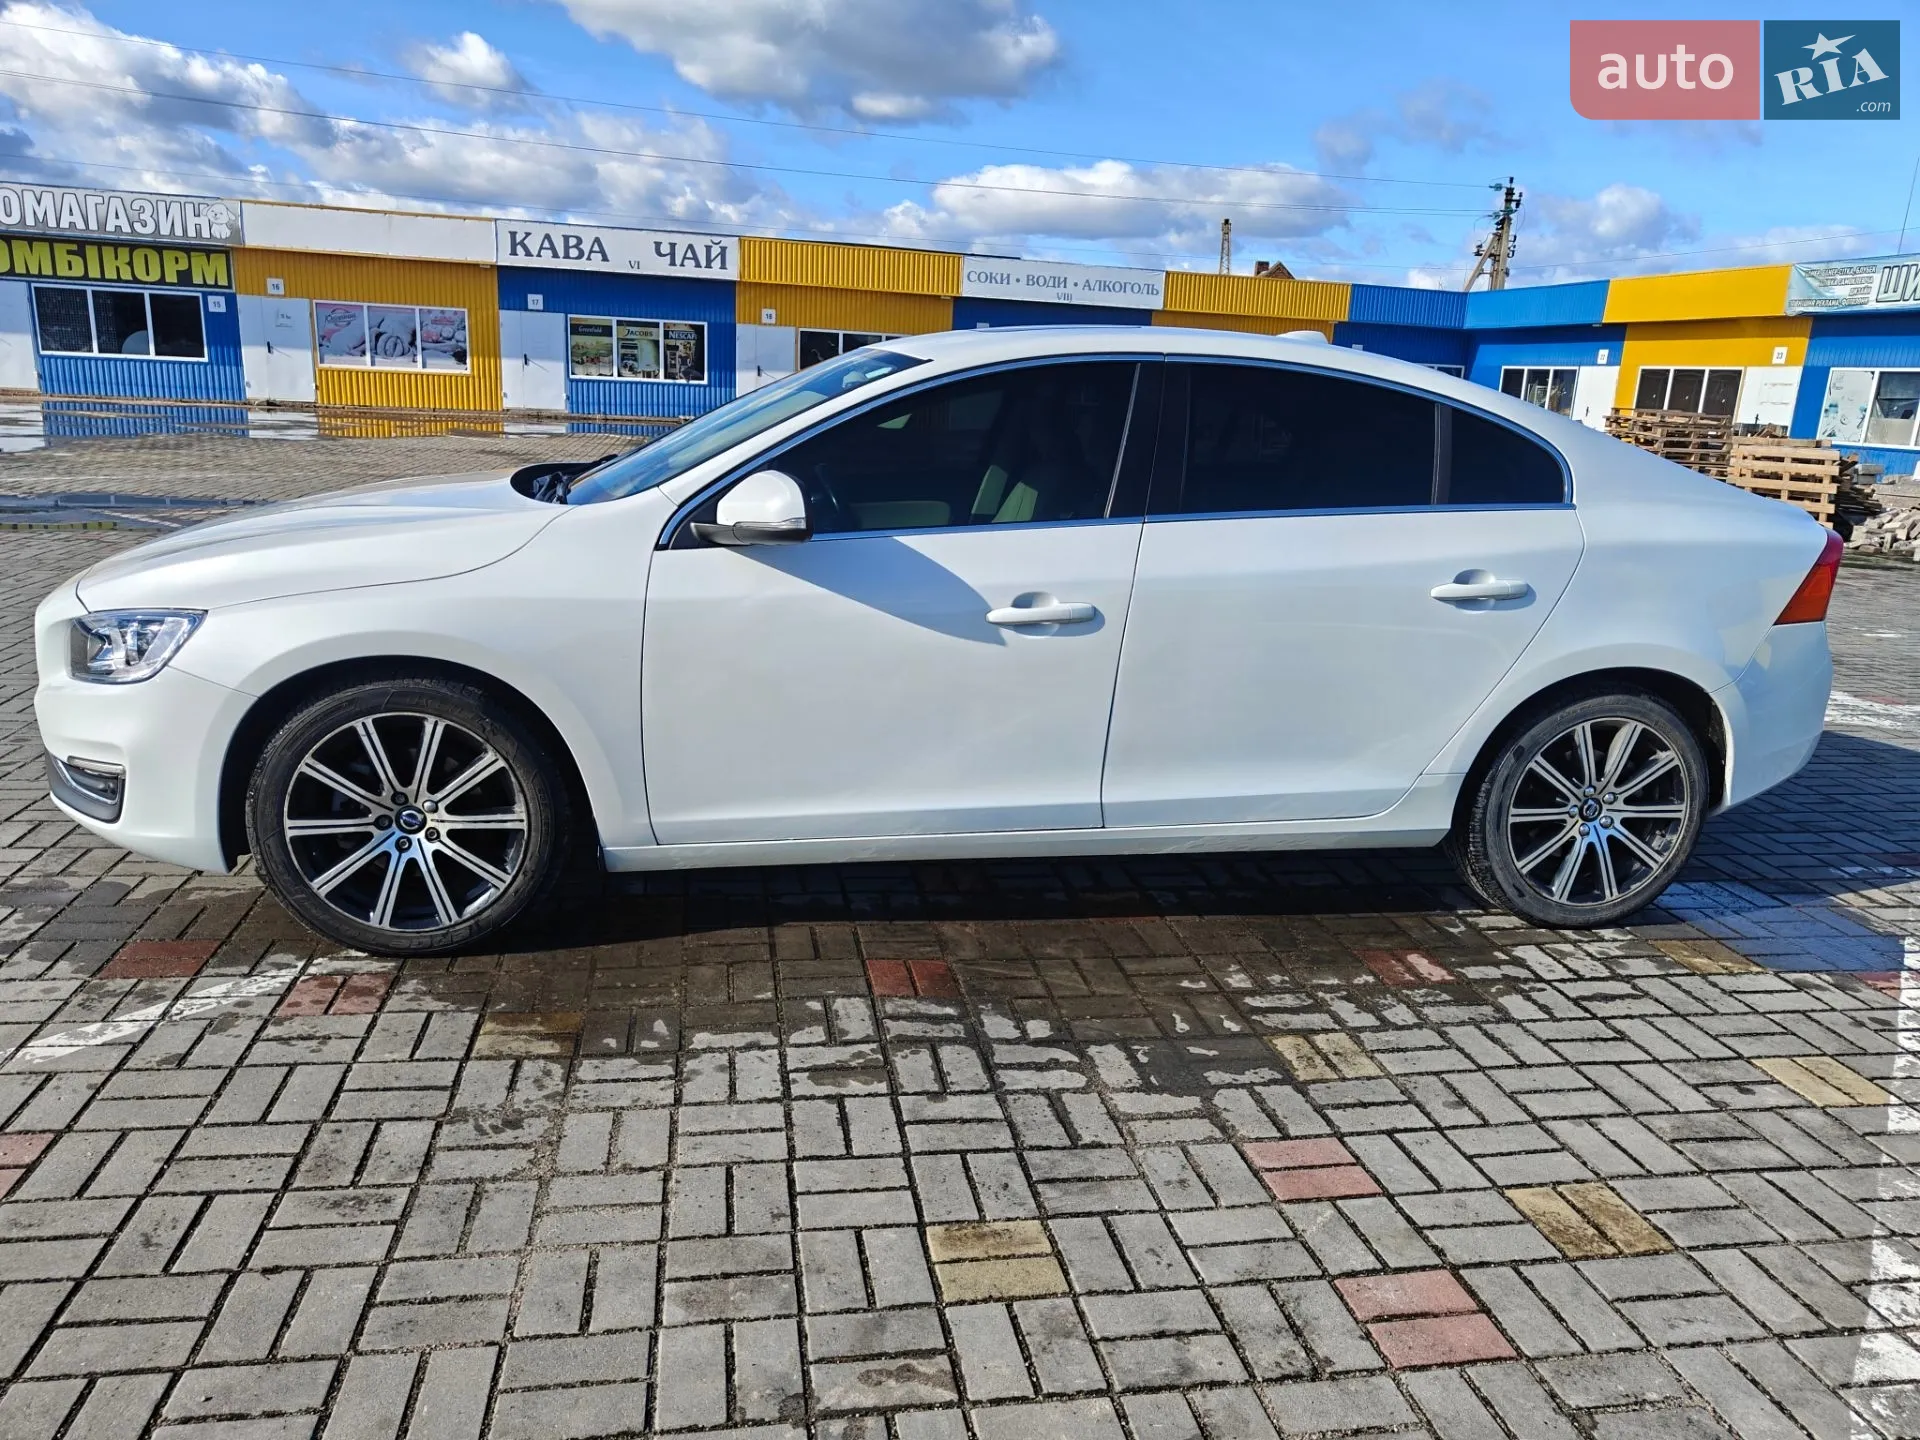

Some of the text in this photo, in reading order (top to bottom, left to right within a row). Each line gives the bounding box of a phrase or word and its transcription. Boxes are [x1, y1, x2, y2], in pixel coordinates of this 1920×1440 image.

[508, 230, 728, 270] КАВА ЧАЙ
[628, 260, 641, 270] VI
[271, 283, 280, 291] 16
[967, 270, 1160, 296] СОКИ ВОДИ АЛКОГОЛЬ
